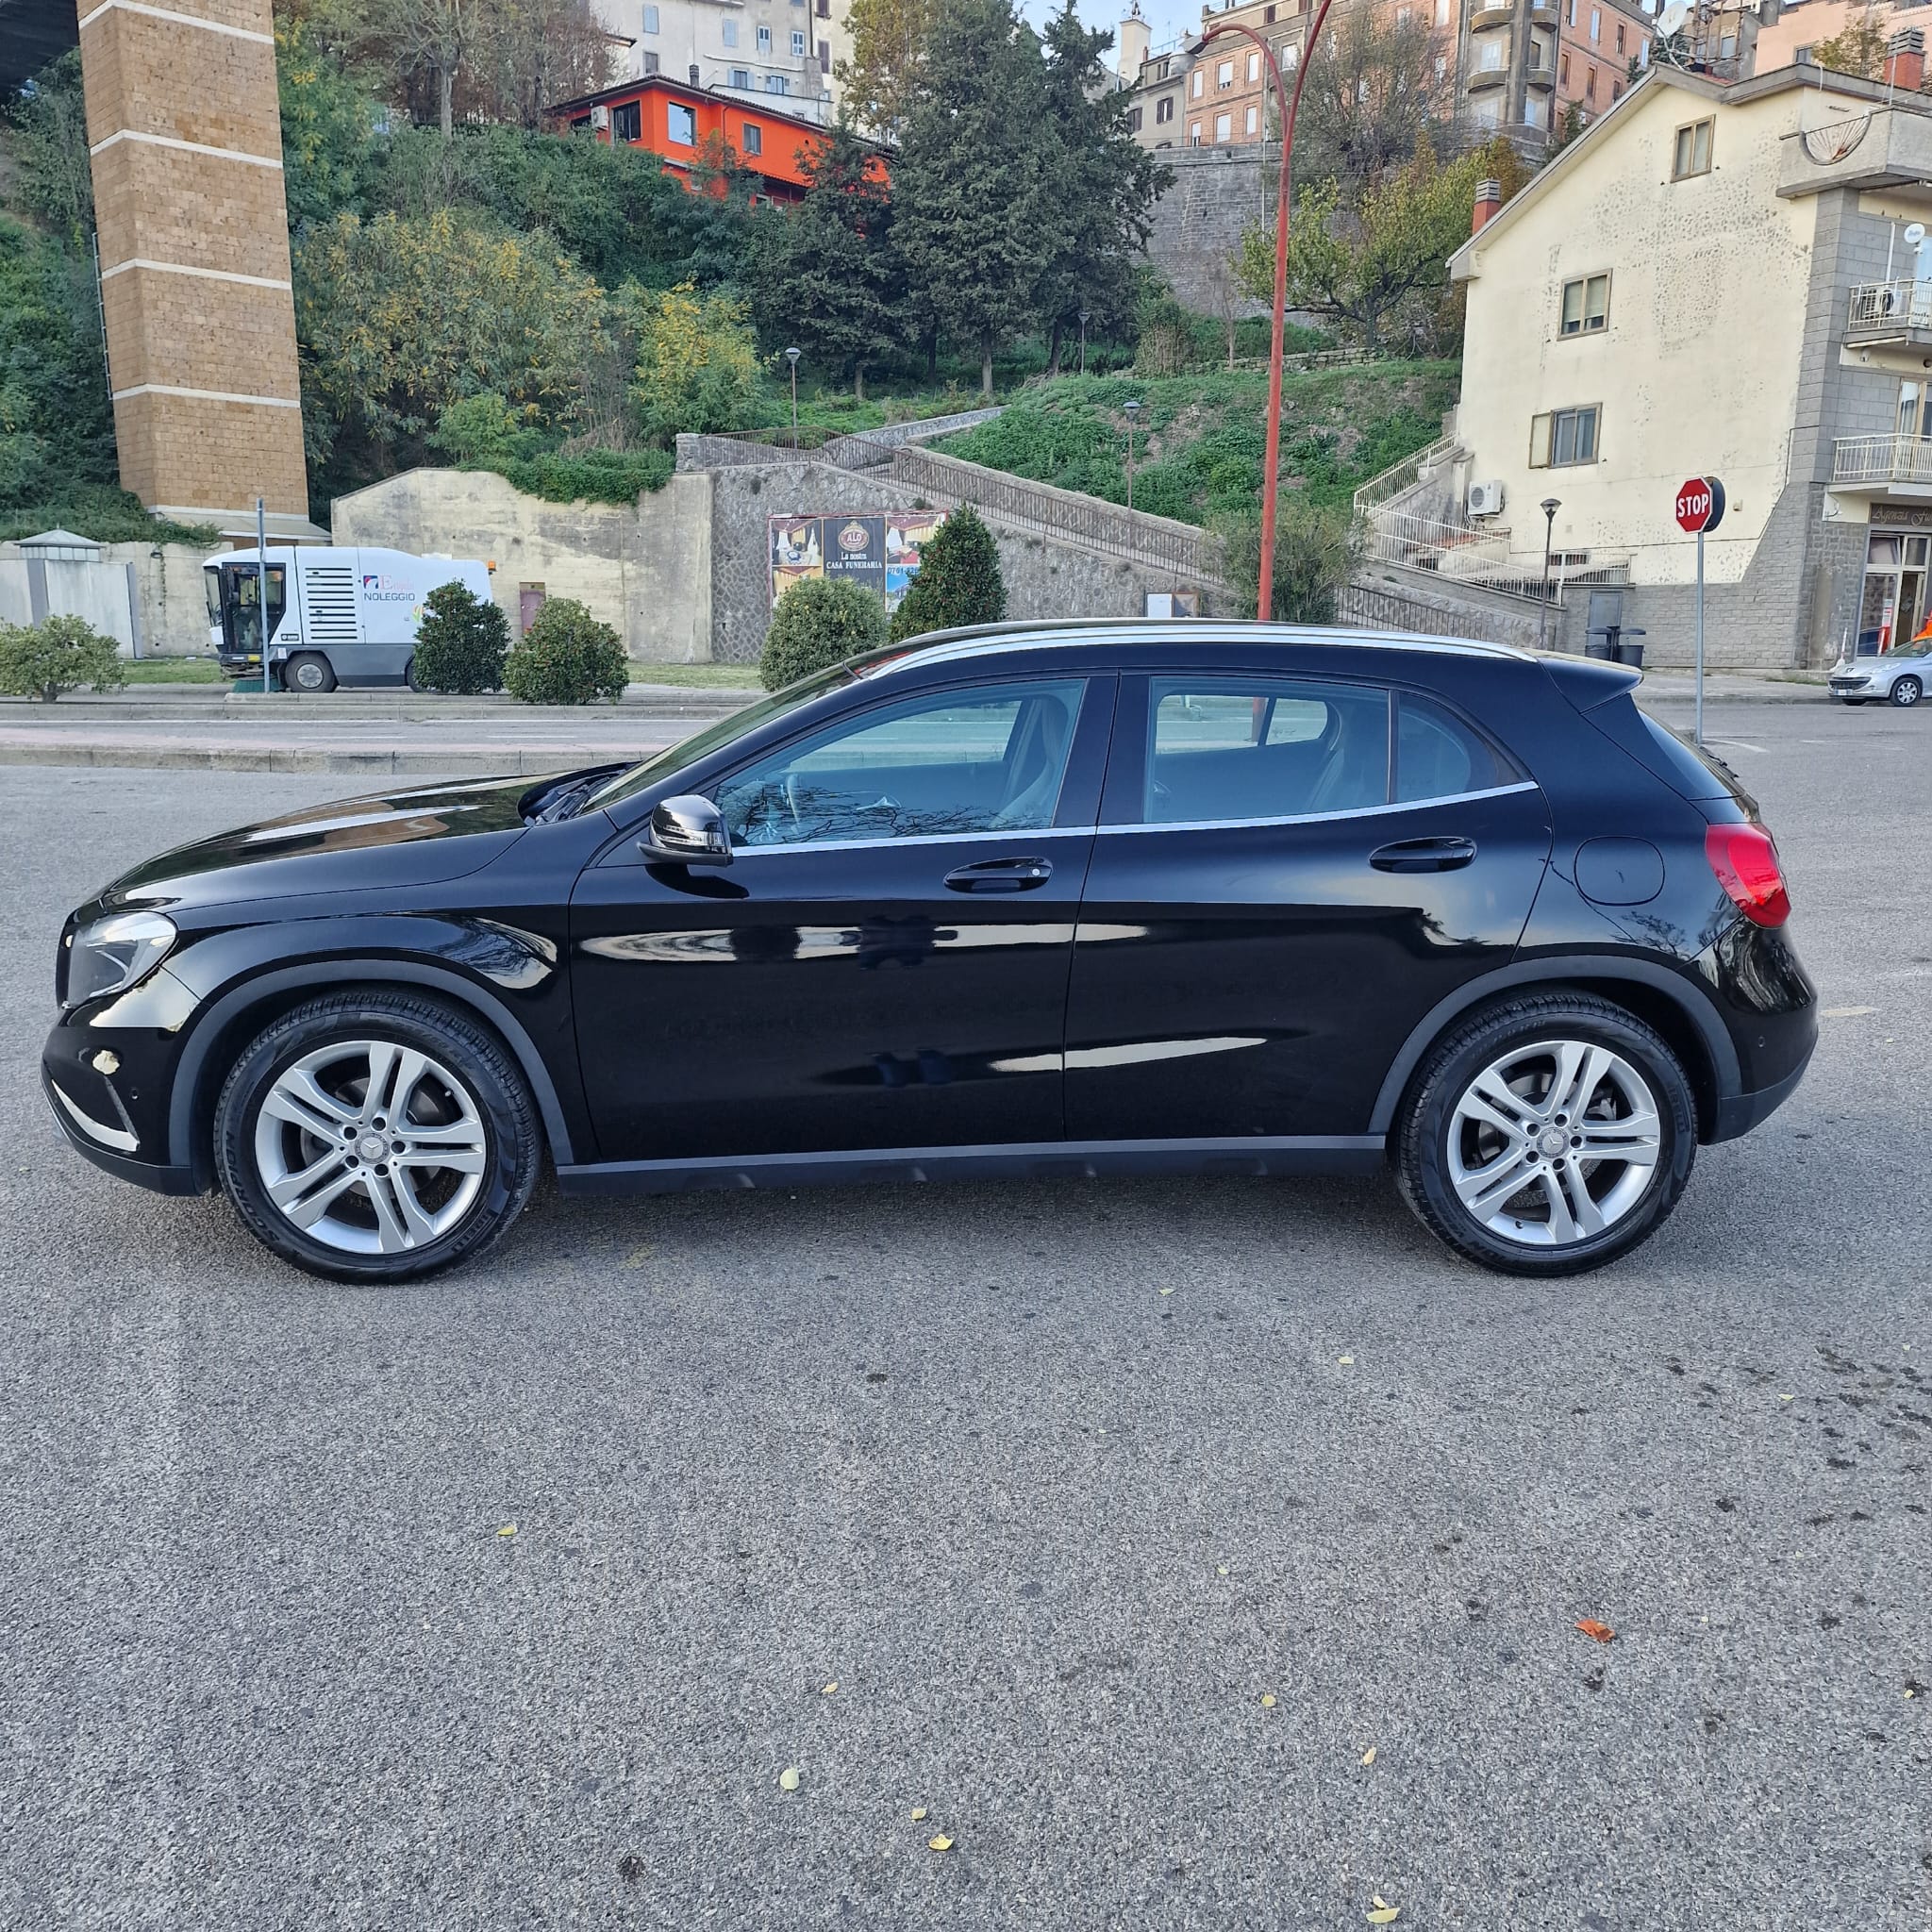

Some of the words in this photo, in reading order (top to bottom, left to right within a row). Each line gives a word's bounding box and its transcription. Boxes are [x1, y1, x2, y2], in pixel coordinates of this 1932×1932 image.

[1677, 493, 1709, 518] STOP
[841, 552, 849, 560] La
[845, 560, 883, 569] FUNERARIA
[363, 592, 415, 601] NOLEGGIO
[225, 1130, 281, 1241] SCORPION
